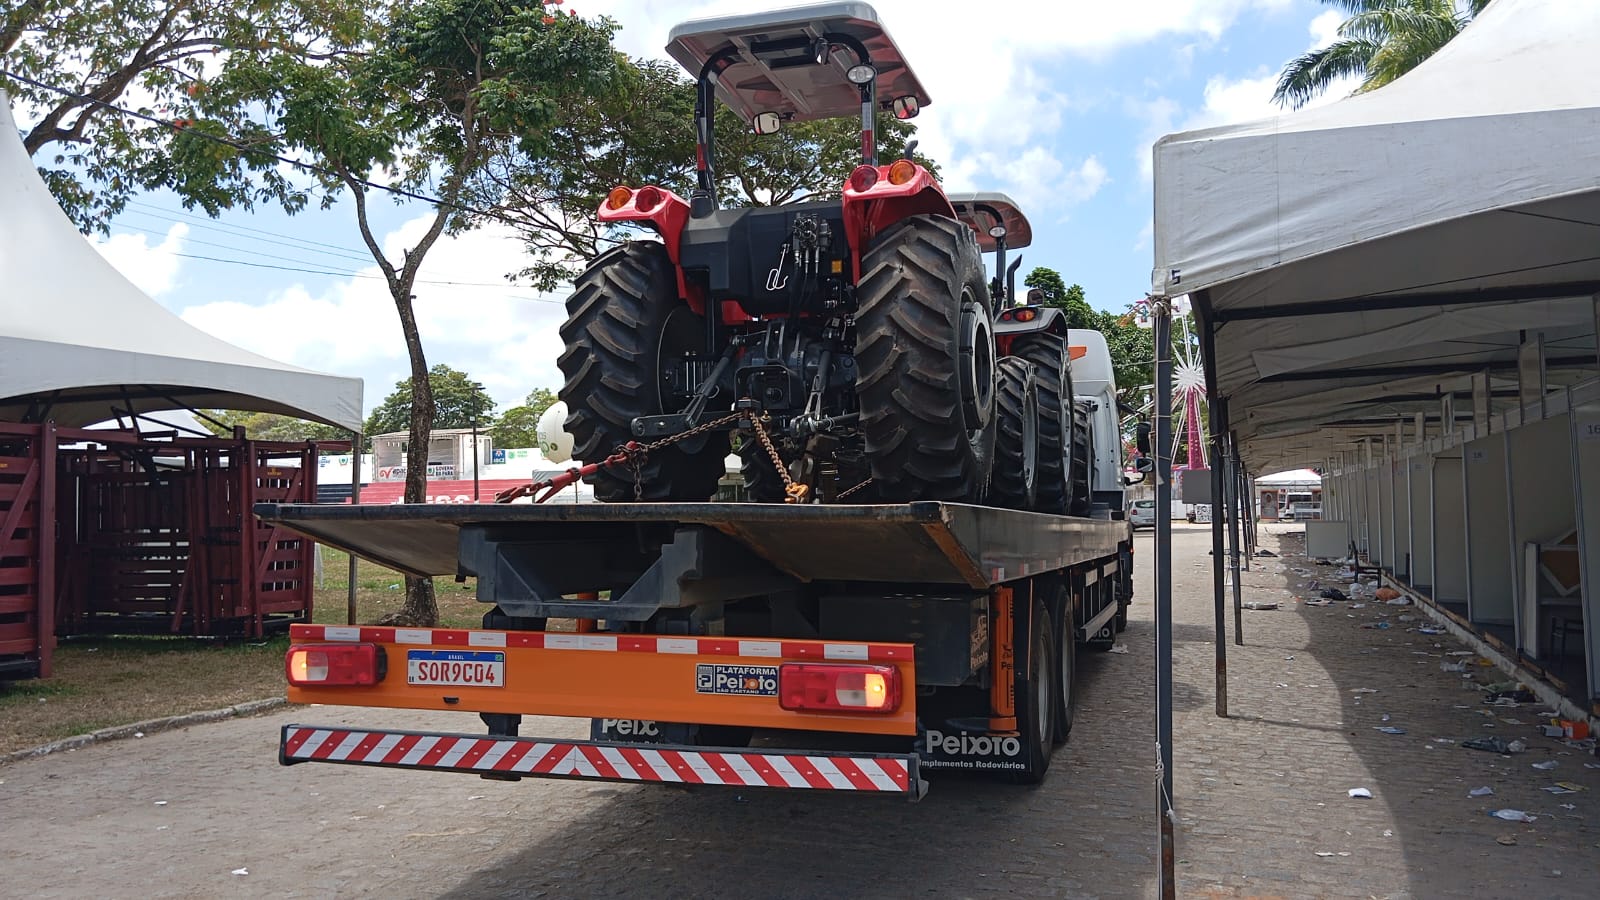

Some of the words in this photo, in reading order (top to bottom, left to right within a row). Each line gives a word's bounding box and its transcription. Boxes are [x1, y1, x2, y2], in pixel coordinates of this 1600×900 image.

[419, 662, 495, 683] SOR9C04
[716, 666, 776, 675] PLATAFORMA
[716, 674, 777, 690] Peixoto
[926, 730, 1021, 756] Peixoto
[919, 759, 973, 769] Implementos
[975, 760, 1026, 770] Rodoviários
